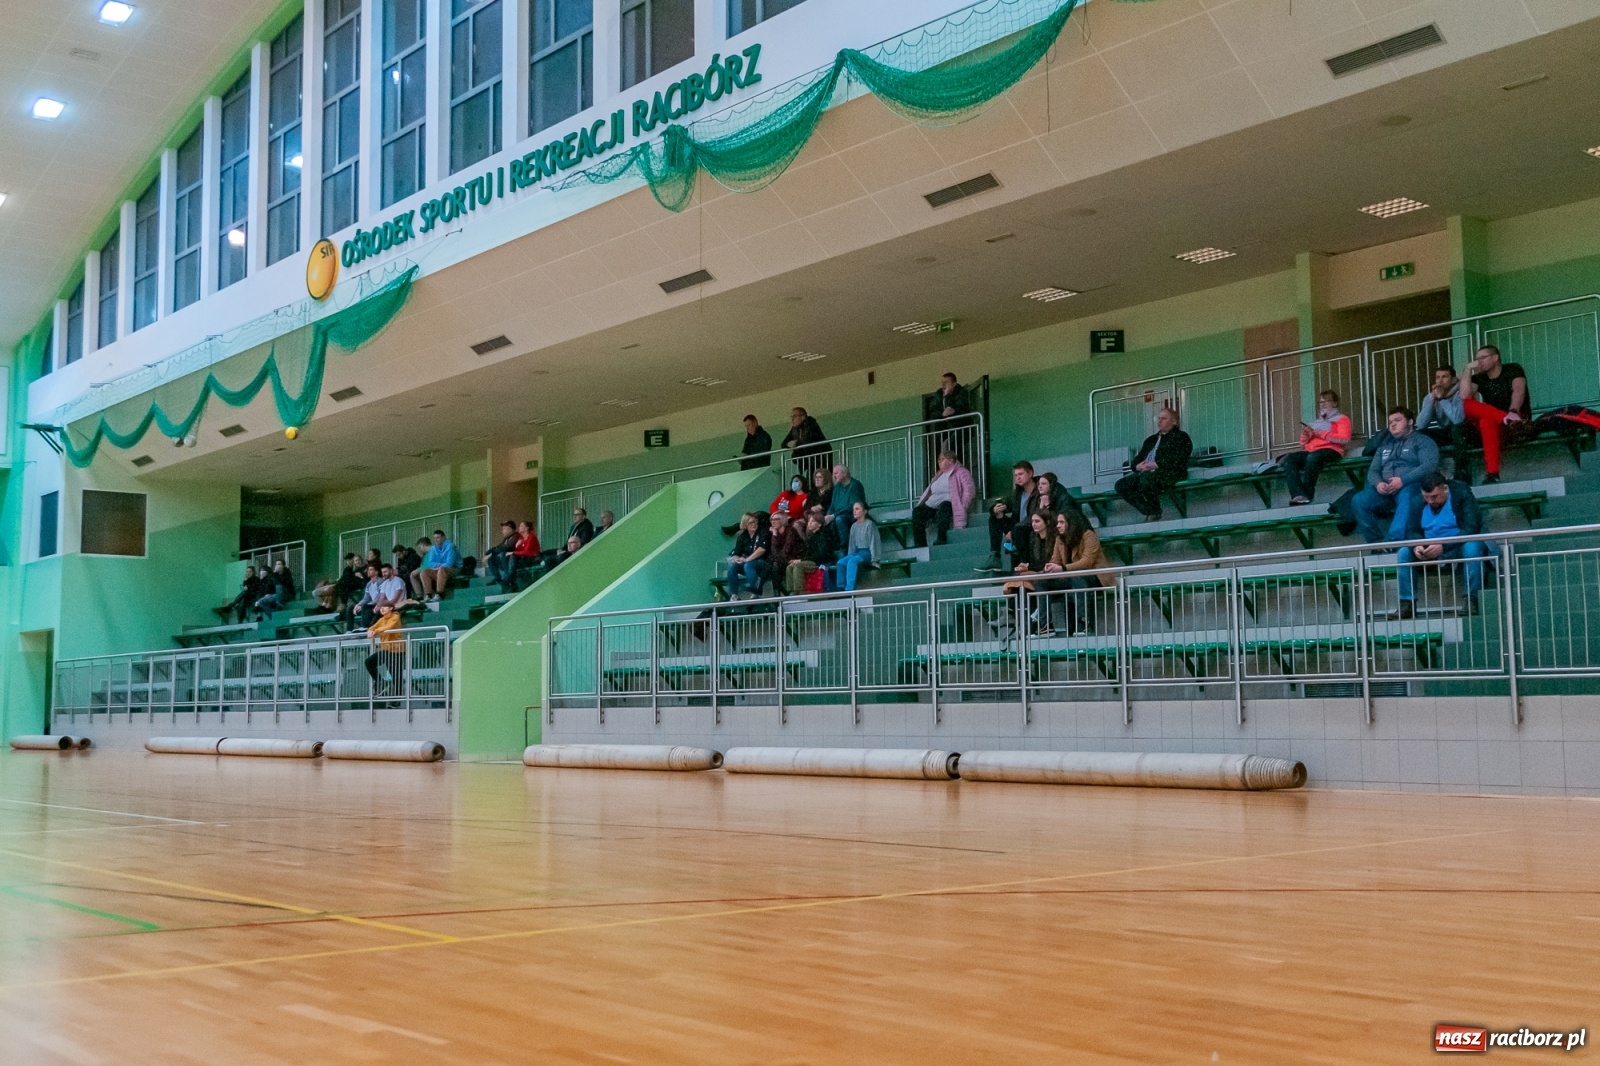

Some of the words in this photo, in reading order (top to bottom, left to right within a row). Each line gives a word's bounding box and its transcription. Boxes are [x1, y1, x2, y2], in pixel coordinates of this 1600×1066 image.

[341, 209, 415, 268] OŚRODEK
[419, 172, 493, 233] SPORTU
[497, 167, 504, 198] I
[509, 109, 625, 193] REKREACJI
[632, 43, 762, 137] RACIBÓRZ
[1100, 337, 1115, 351] F
[650, 435, 663, 446] E
